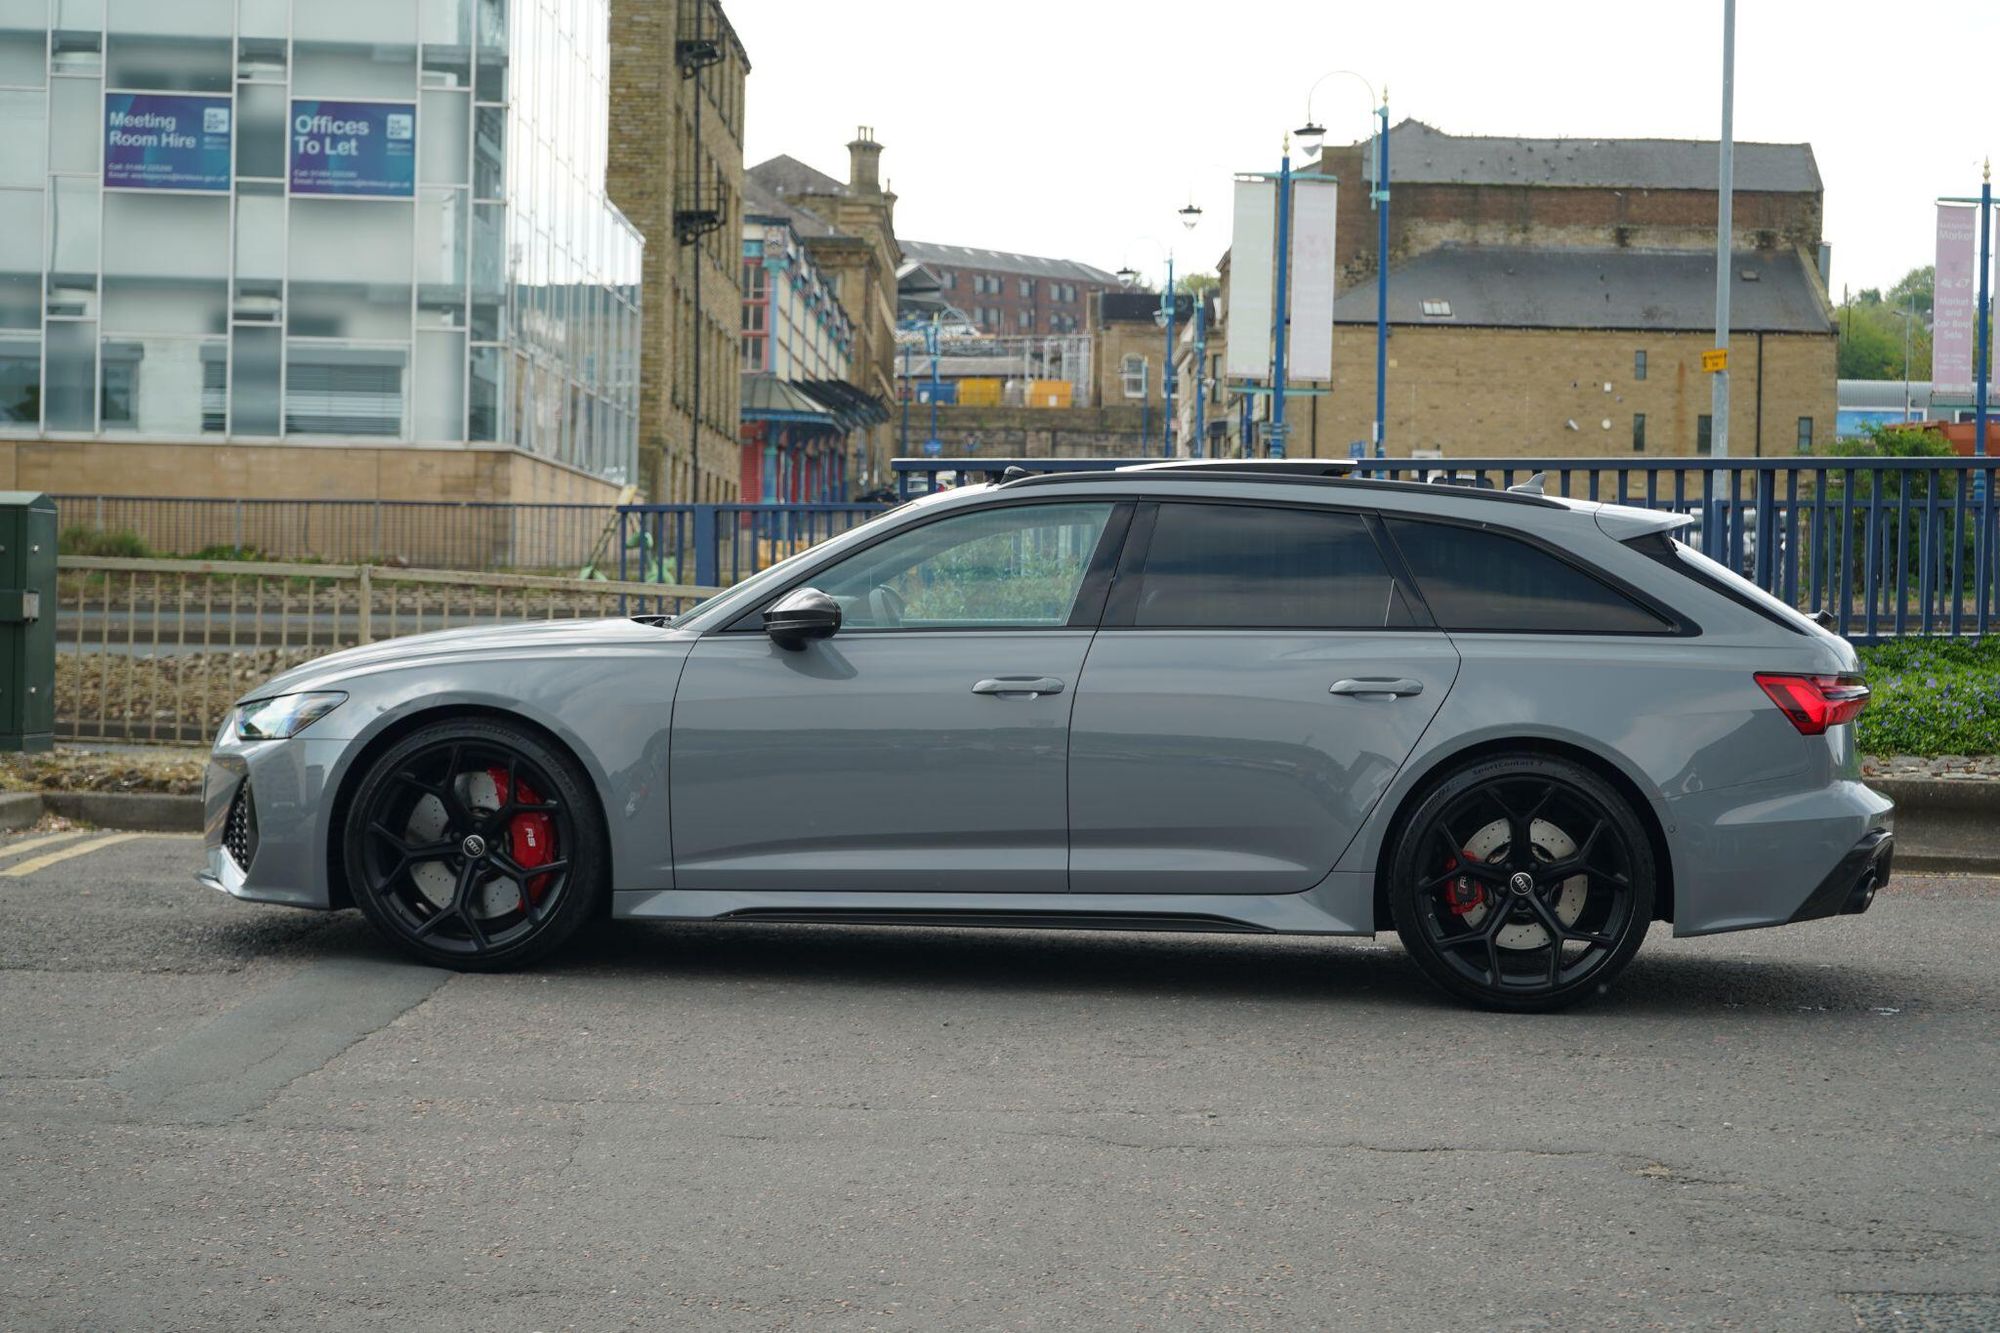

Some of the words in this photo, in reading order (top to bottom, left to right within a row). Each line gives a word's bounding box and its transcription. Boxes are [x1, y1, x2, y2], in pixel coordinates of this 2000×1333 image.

[109, 111, 176, 132] Meeting
[295, 115, 370, 136] Offices
[109, 130, 158, 147] Room
[161, 132, 197, 149] Hire
[294, 136, 320, 155] To
[324, 137, 359, 156] Let
[525, 827, 536, 848] RS
